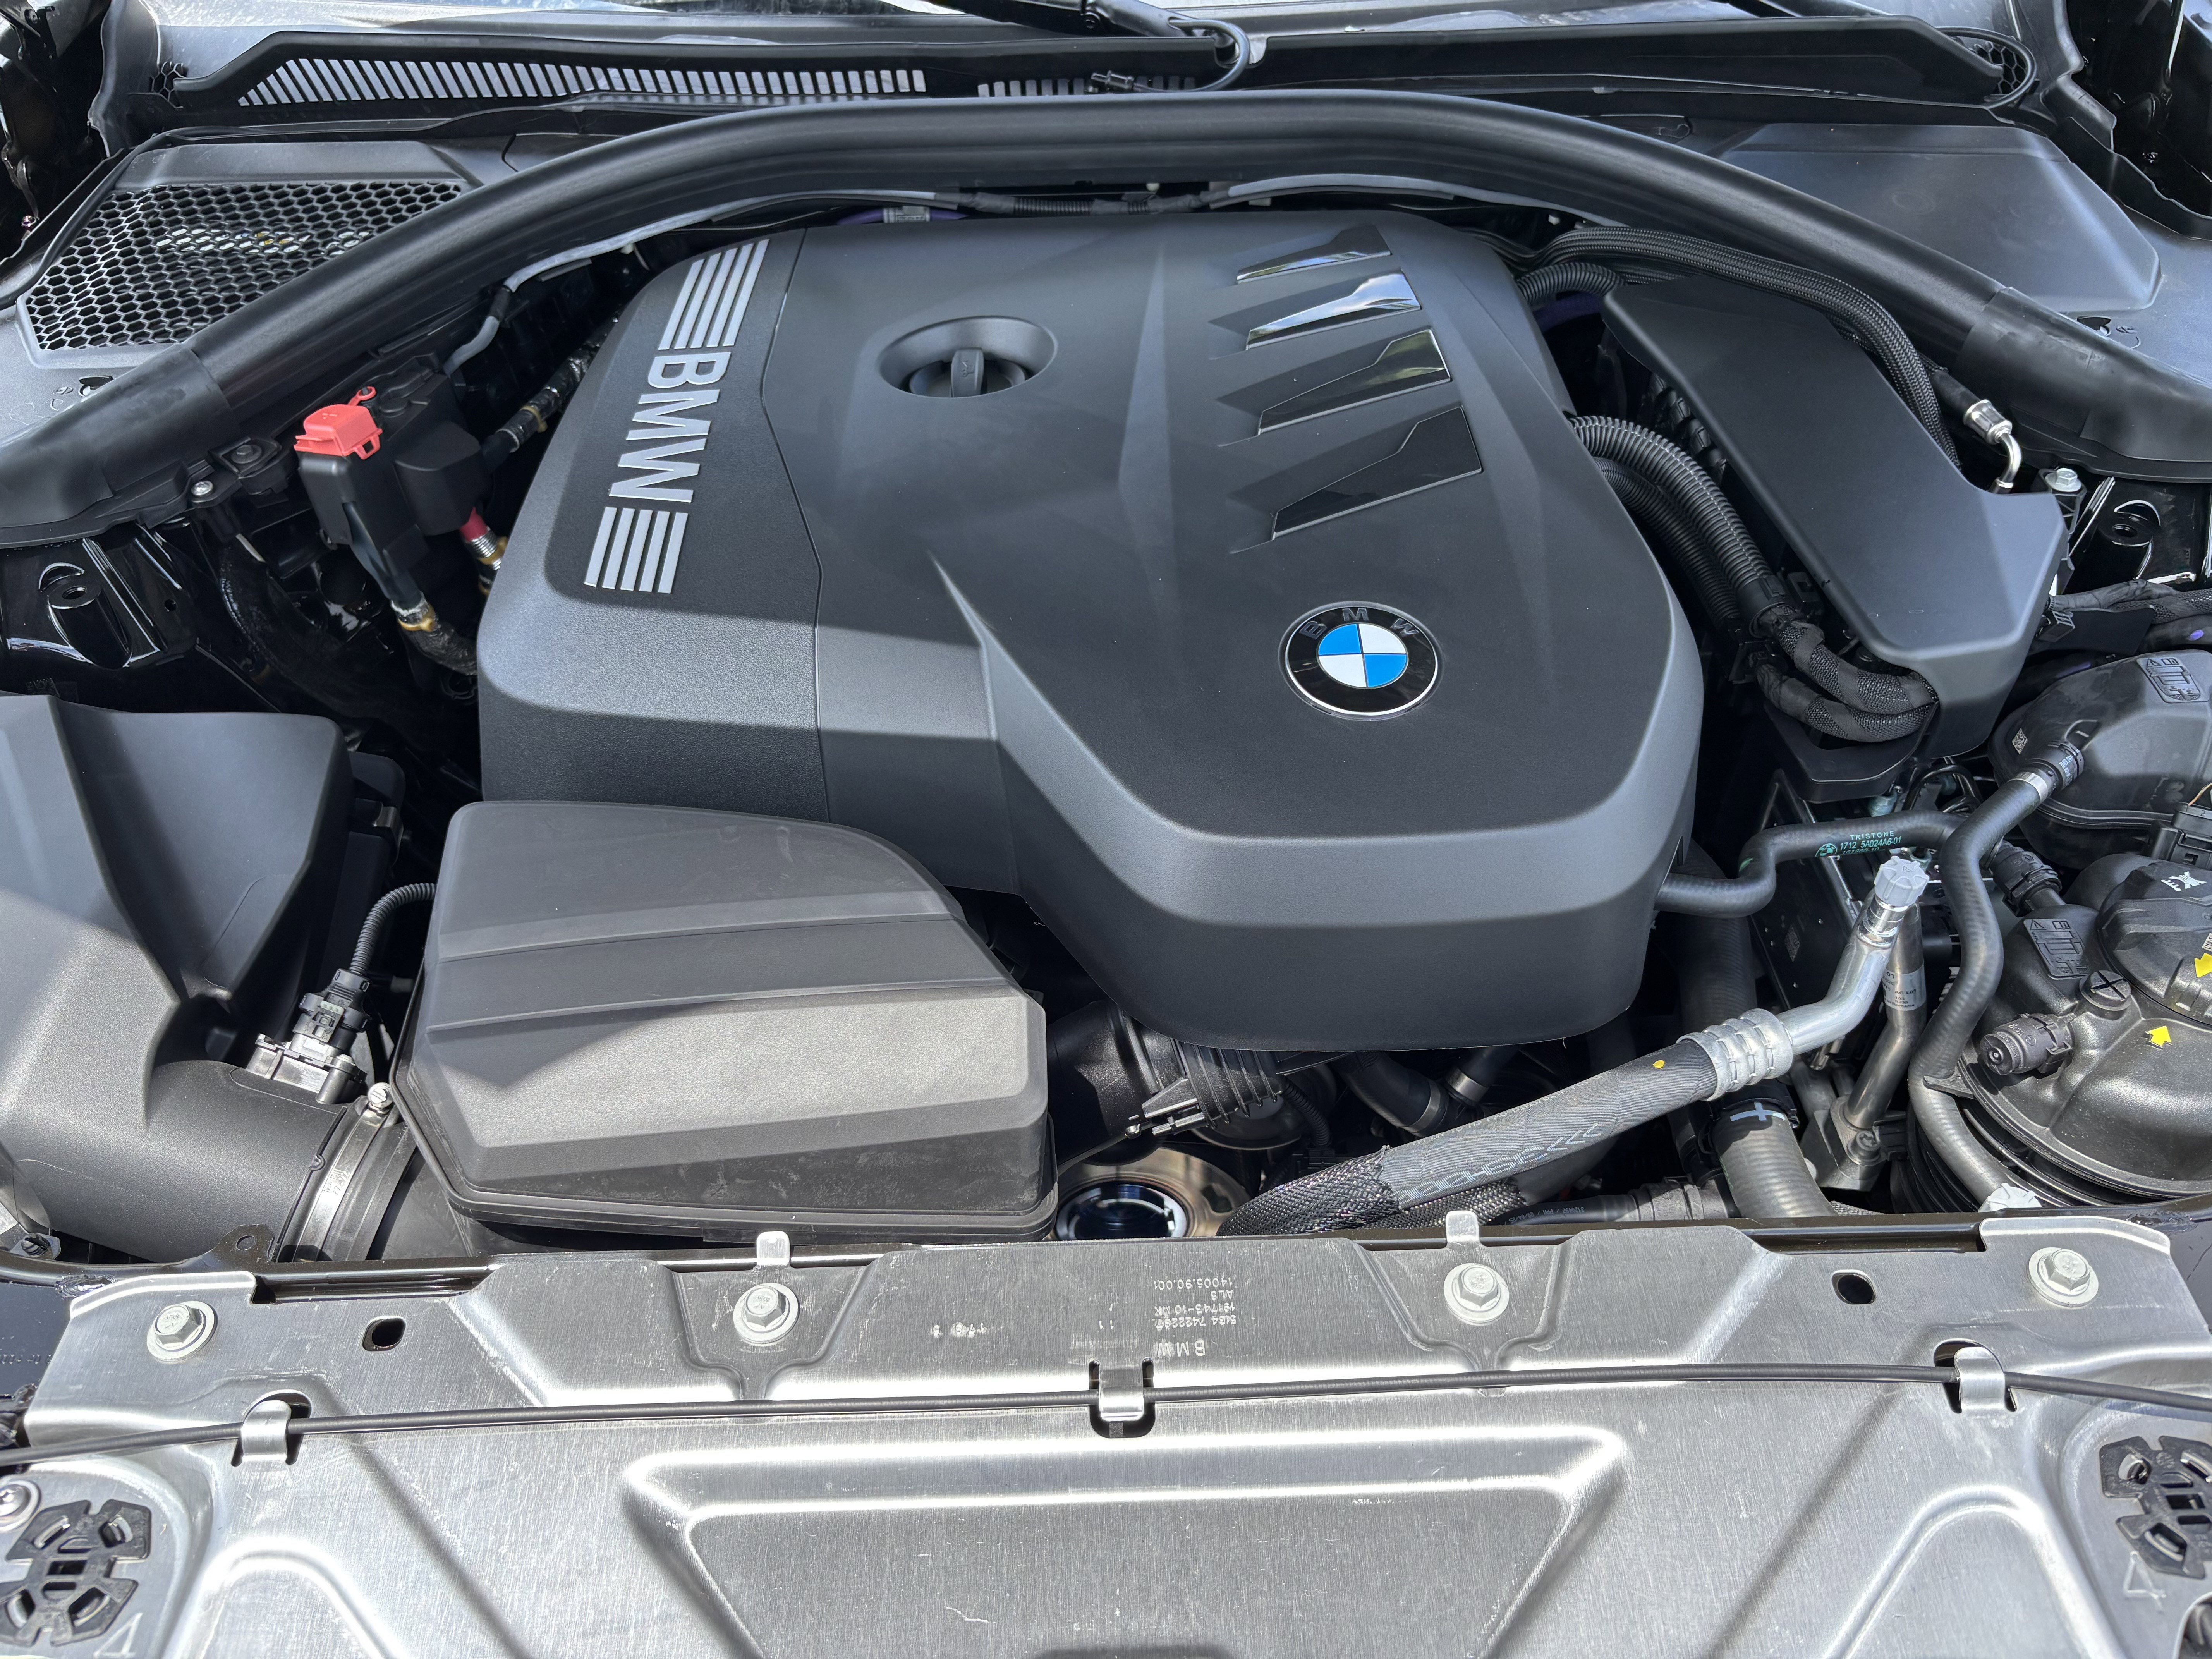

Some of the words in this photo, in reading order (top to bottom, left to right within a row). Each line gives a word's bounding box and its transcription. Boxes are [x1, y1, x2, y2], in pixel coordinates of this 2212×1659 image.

[609, 351, 731, 503] BMW
[1299, 608, 1419, 640] BMW
[1840, 841, 1857, 850] 1712
[1860, 836, 1901, 848] 5A024A6-01
[1850, 831, 1894, 840] TRISTONE
[1157, 1339, 1206, 1357] BMW
